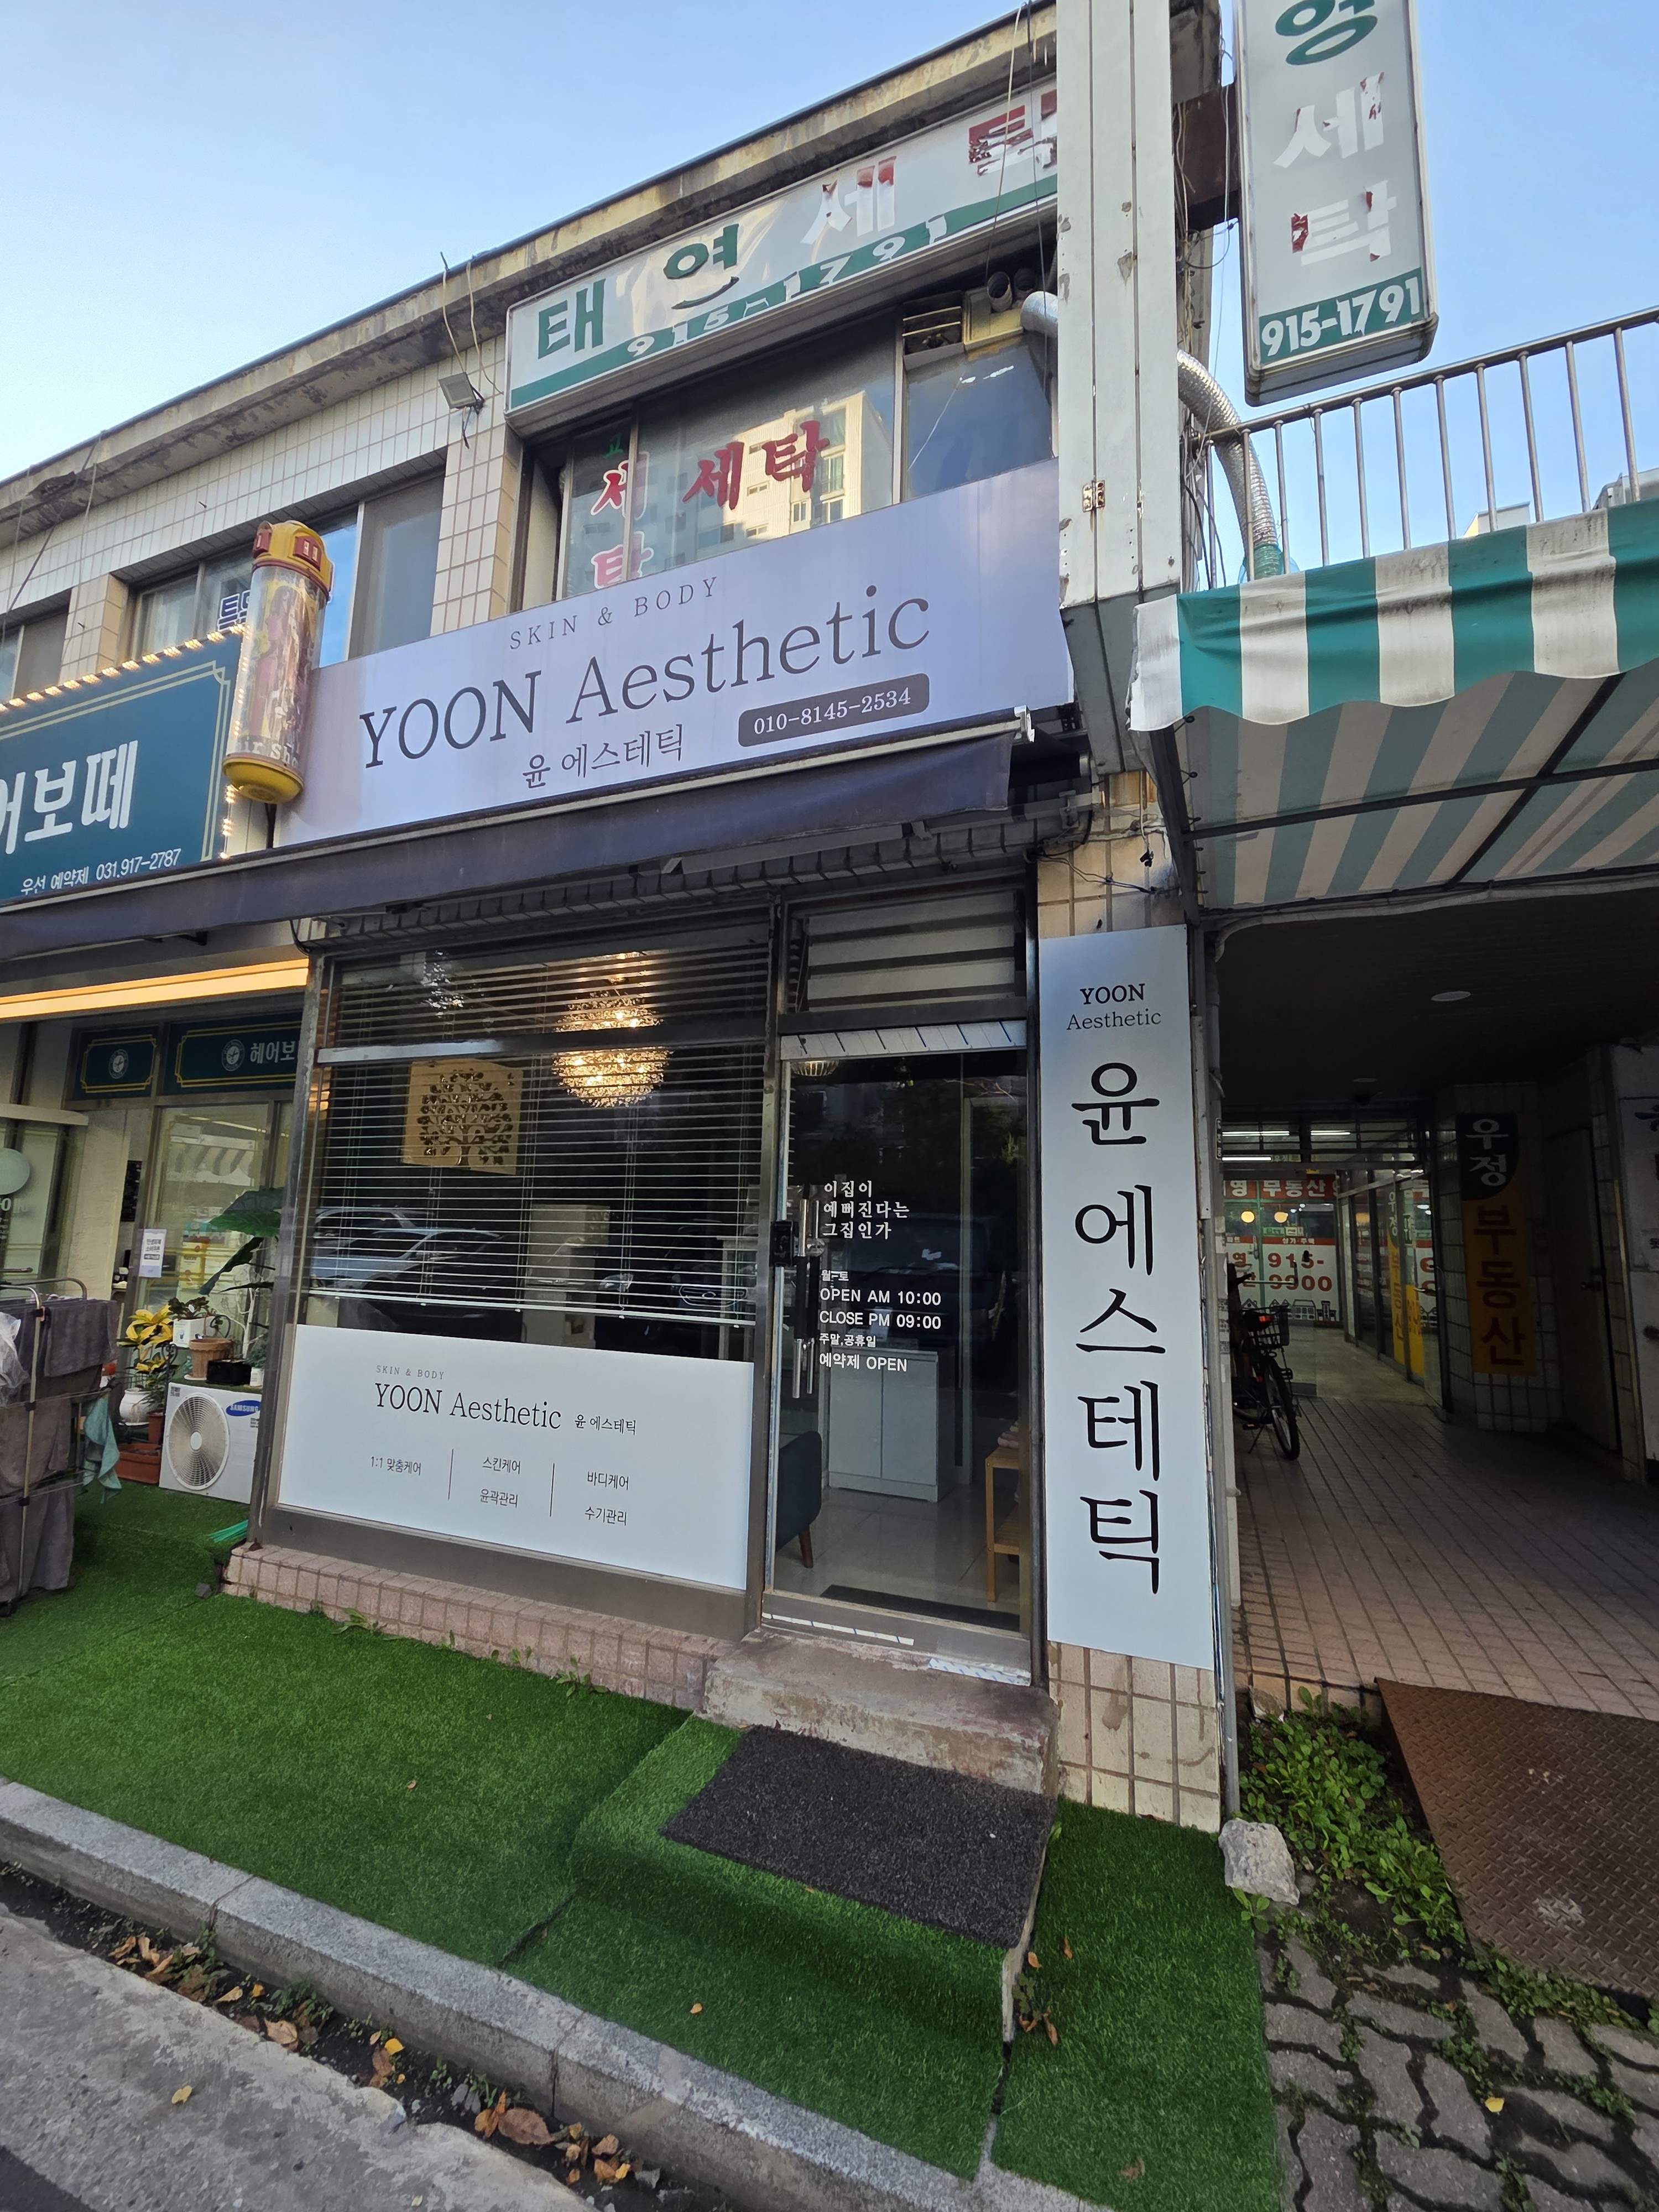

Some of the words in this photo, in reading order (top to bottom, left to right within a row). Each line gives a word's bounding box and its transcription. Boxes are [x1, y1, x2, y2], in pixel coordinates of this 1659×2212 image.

[1272, 72, 1397, 266] 세탁
[1261, 276, 1421, 357] 915-1791
[682, 420, 830, 510] 세탁
[509, 615, 577, 650] SKIN
[598, 607, 613, 626] &
[634, 576, 717, 617] BODY
[359, 671, 541, 770] YOON
[565, 585, 930, 724] Aesthetic
[754, 687, 911, 735] 010-8145-2534
[522, 754, 551, 789] 윤
[561, 723, 683, 779] 에스테틱
[51, 866, 89, 890] 예약제
[96, 848, 181, 881] 031.917-2787
[1080, 984, 1145, 1005] YOON
[1067, 1009, 1162, 1030] Aesthetic
[250, 1041, 296, 1064] 헤어보
[1071, 1062, 1160, 1145] 윤
[1464, 1118, 1510, 1187] 우정
[823, 1201, 910, 1219] 예뻐진다는
[1473, 1204, 1527, 1366] 부동산
[820, 1288, 861, 1302] OPEN
[867, 1290, 890, 1303] AM
[898, 1291, 941, 1306] 10:00
[820, 1310, 863, 1326] CLOSE
[868, 1313, 890, 1327] PM
[896, 1314, 941, 1329] 09:00
[375, 1365, 400, 1375] SKIN
[405, 1368, 411, 1376] &
[418, 1369, 444, 1380] BODY
[820, 1352, 860, 1370] 예약제
[866, 1356, 907, 1371] OPEN
[1074, 1184, 1166, 1595] 에스테틱
[230, 1404, 259, 1412] SAMSUNG
[375, 1383, 442, 1414] YOON
[449, 1392, 561, 1429] Aesthetic
[575, 1414, 586, 1429] 윤
[589, 1416, 636, 1436] 에스테틱
[371, 1456, 383, 1468] 1:1
[387, 1458, 421, 1476] 맞춤케어
[482, 1457, 521, 1475] 스킨케어
[587, 1471, 629, 1491] 바디케어
[479, 1489, 518, 1508] 윤곽관리
[585, 1506, 627, 1526] 수기관리
